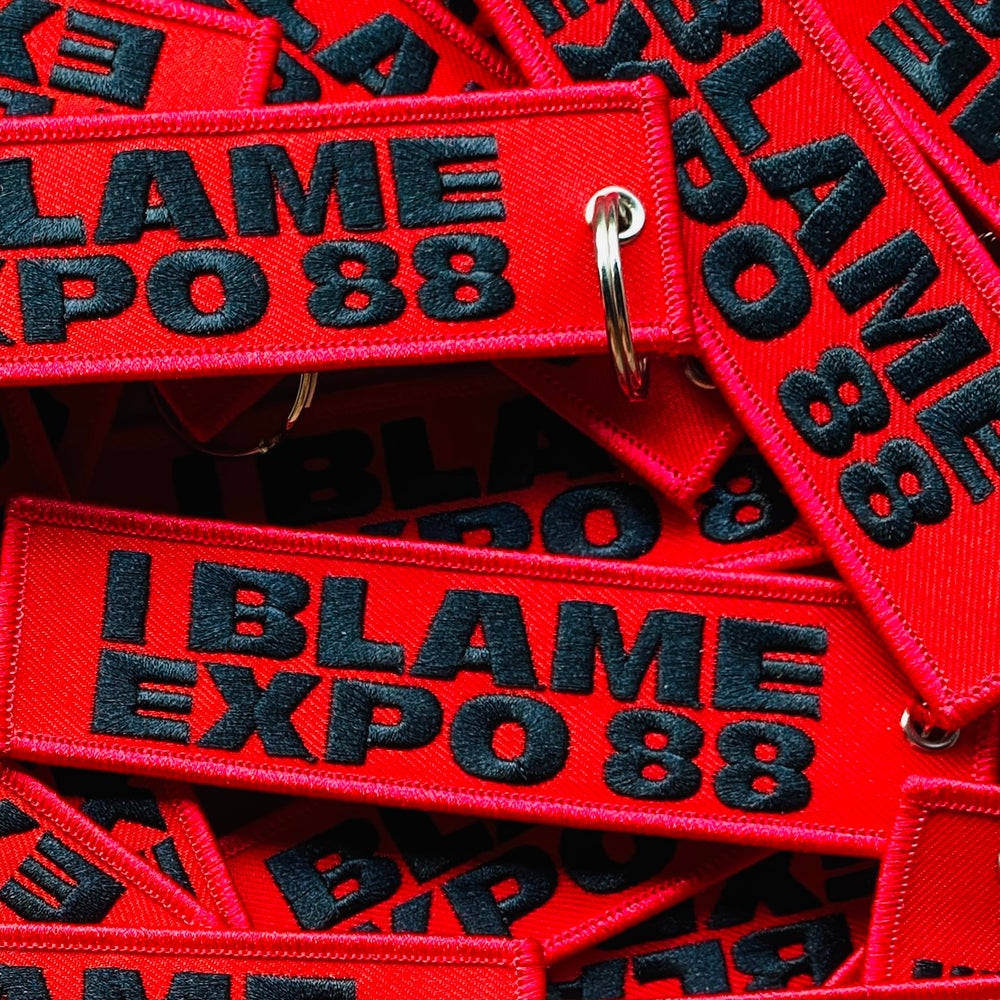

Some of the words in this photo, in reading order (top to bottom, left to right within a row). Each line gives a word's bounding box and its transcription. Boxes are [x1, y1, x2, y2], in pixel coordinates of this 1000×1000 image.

[302, 231, 516, 329] 88
[700, 455, 800, 545] 8
[779, 346, 953, 548] 88
[102, 550, 152, 645] I
[187, 560, 828, 720] BLAME
[90, 648, 571, 785] EXPO
[603, 708, 817, 813] 88
